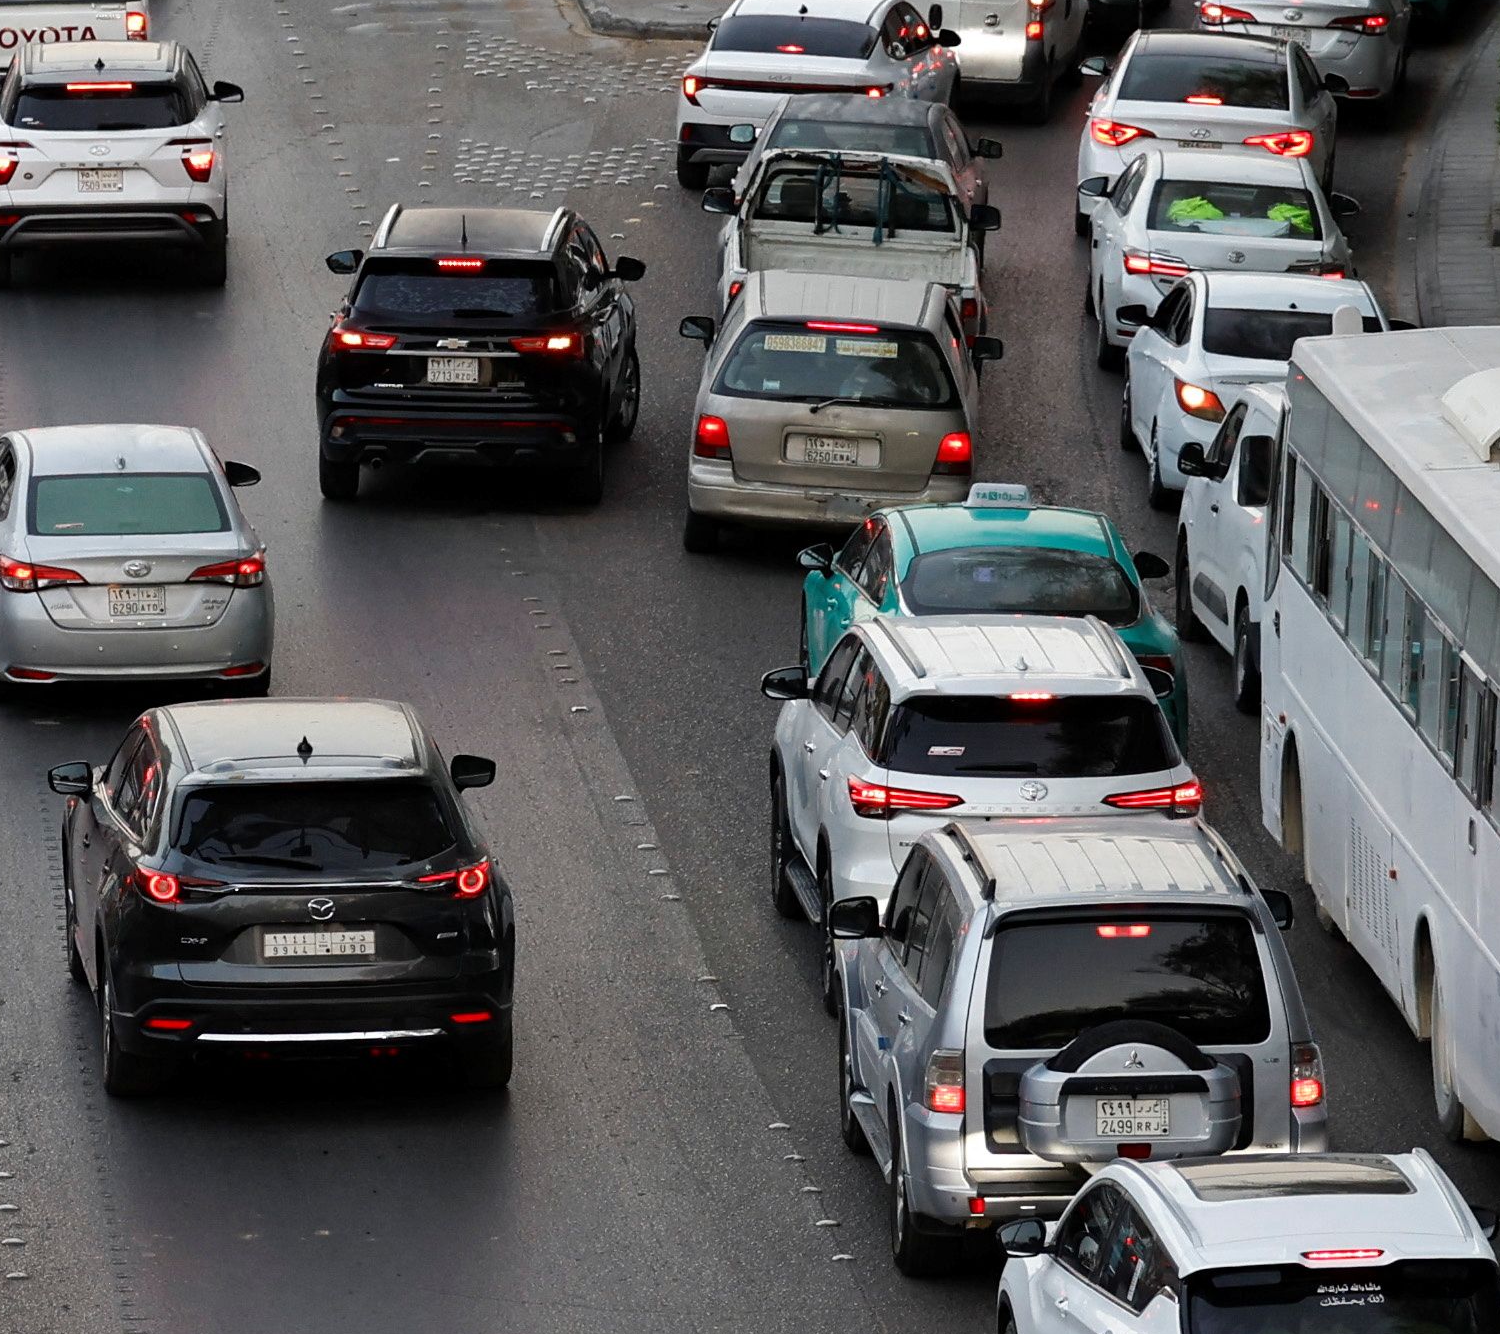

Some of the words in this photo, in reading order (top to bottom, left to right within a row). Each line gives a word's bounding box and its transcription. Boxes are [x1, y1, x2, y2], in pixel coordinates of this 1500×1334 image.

[807, 451, 831, 462] 6250
[112, 602, 138, 614] 6290
[1101, 1101, 1132, 1116] ٢٤٩٩
[1101, 1119, 1133, 1134] 2499
[1136, 1121, 1160, 1132] RRJ
